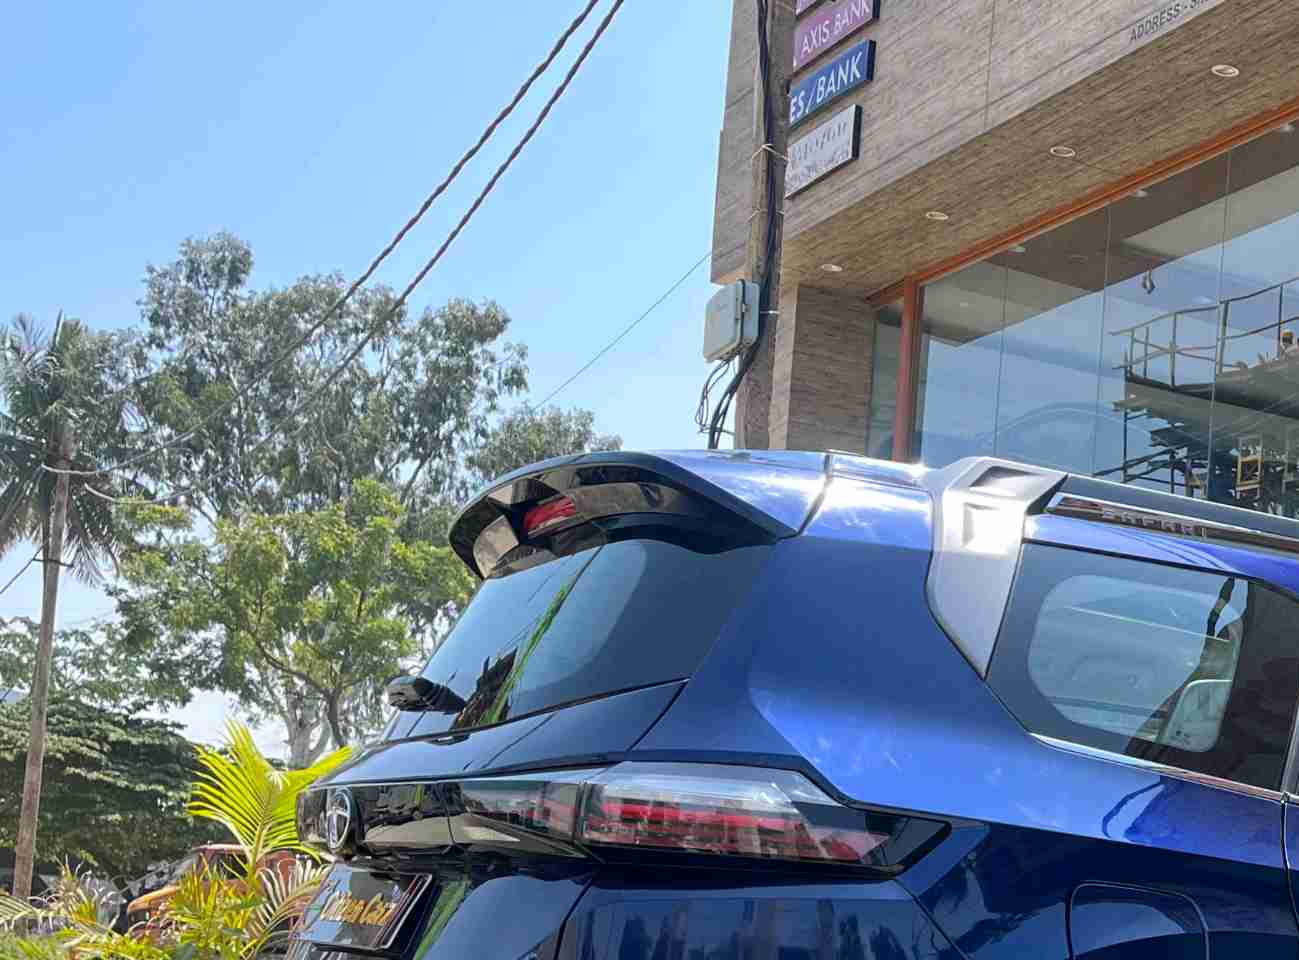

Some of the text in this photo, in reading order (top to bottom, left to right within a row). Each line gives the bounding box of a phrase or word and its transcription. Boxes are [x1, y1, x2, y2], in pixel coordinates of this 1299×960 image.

[801, 0, 870, 57] AXIS BANK
[816, 51, 863, 103] BANK
